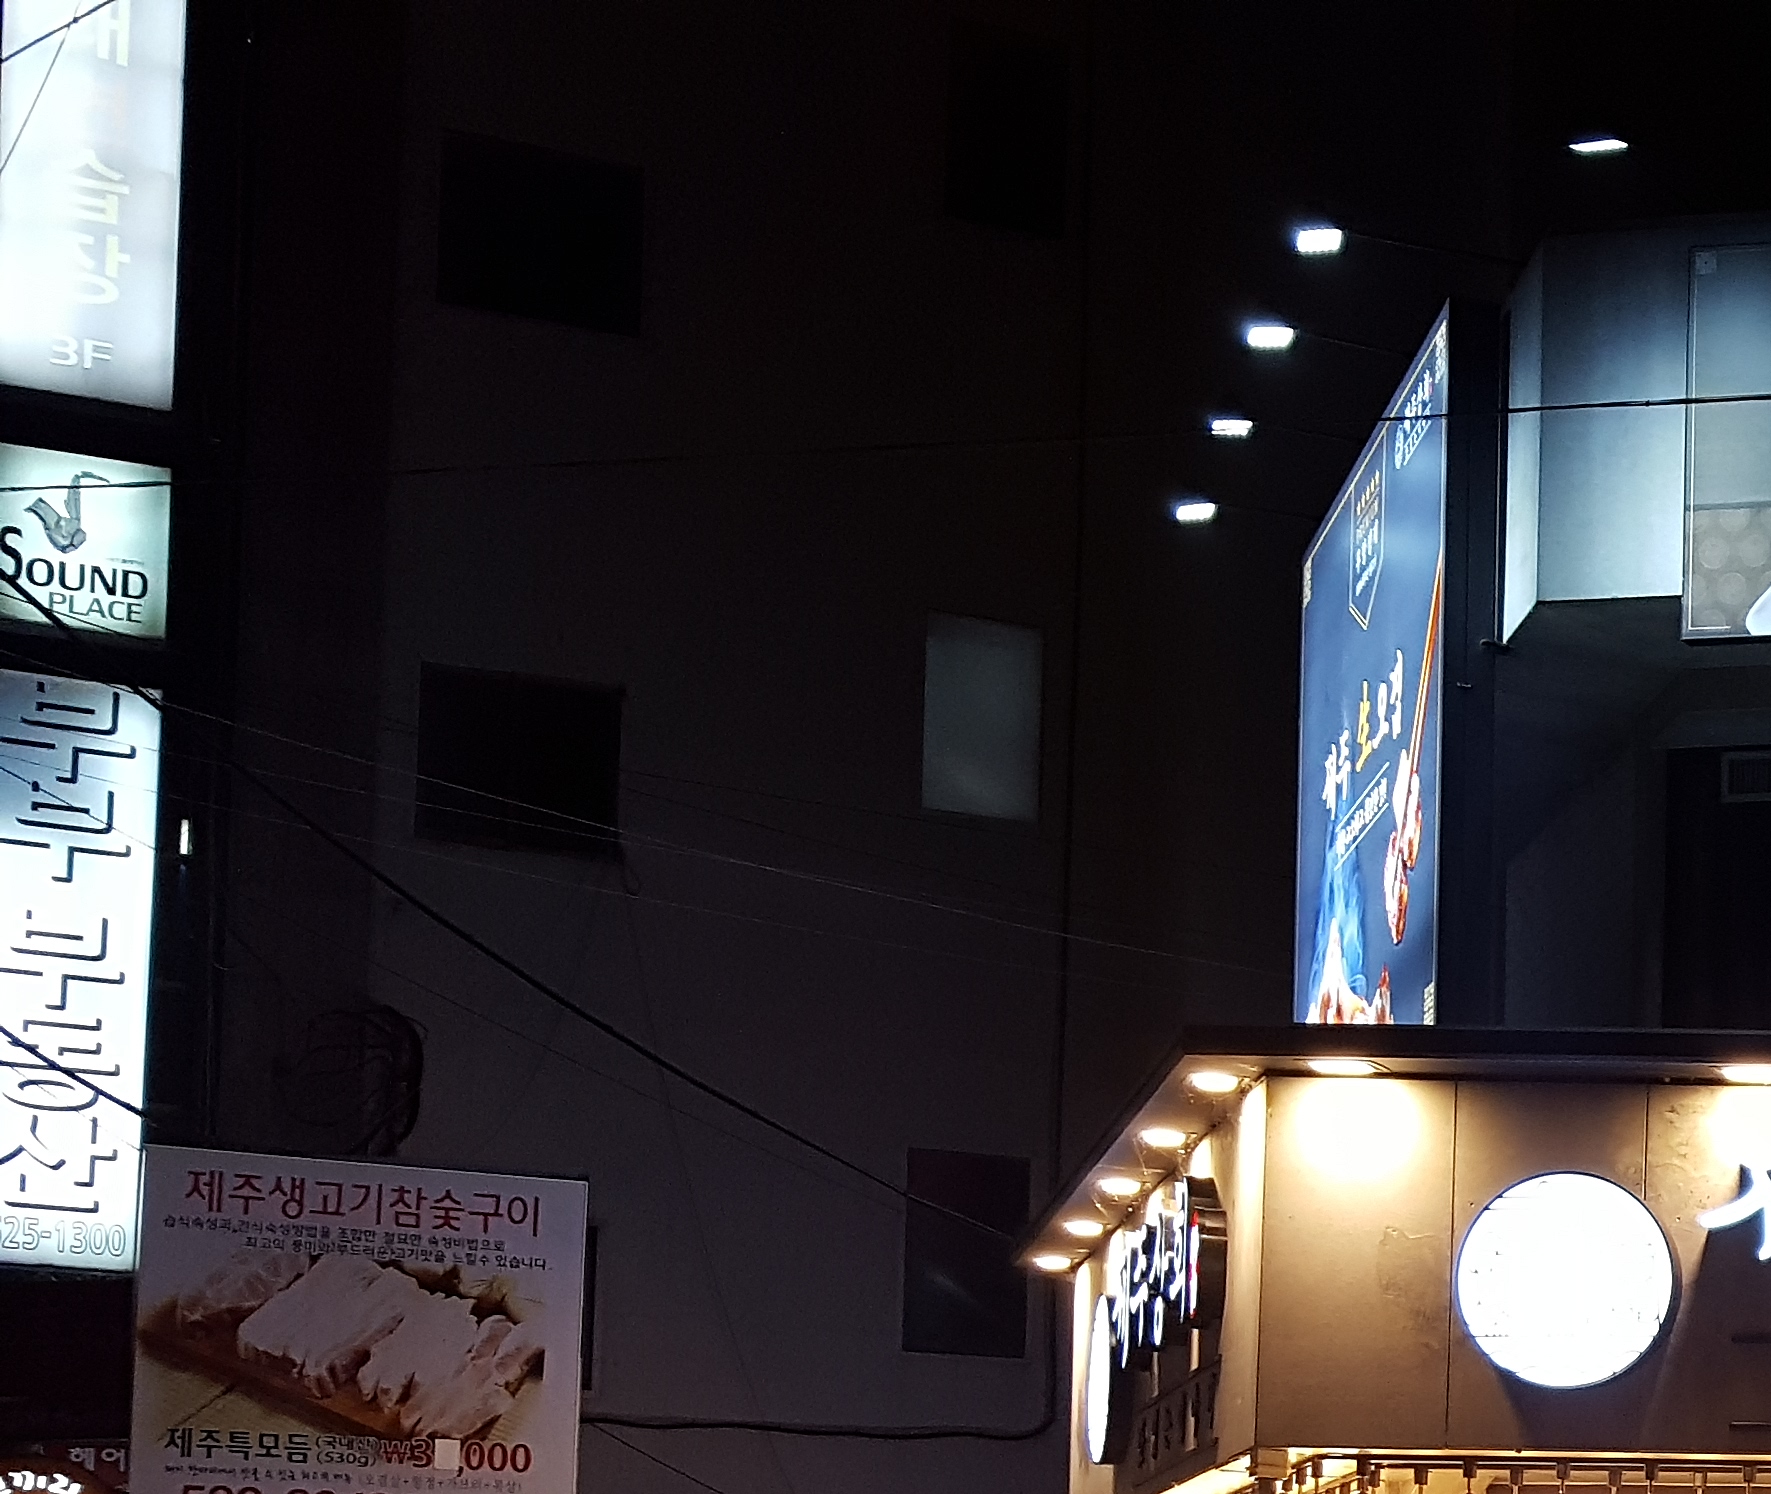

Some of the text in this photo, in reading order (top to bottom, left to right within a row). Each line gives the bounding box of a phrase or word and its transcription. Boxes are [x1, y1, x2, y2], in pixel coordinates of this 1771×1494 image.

[48, 591, 145, 624] PLACE
[184, 1168, 541, 1238] 제주생고기참숯구이
[0, 1215, 127, 1259] 25-1300
[164, 1427, 312, 1464] 제주특모듬
[380, 1437, 532, 1478] ₩3,000
